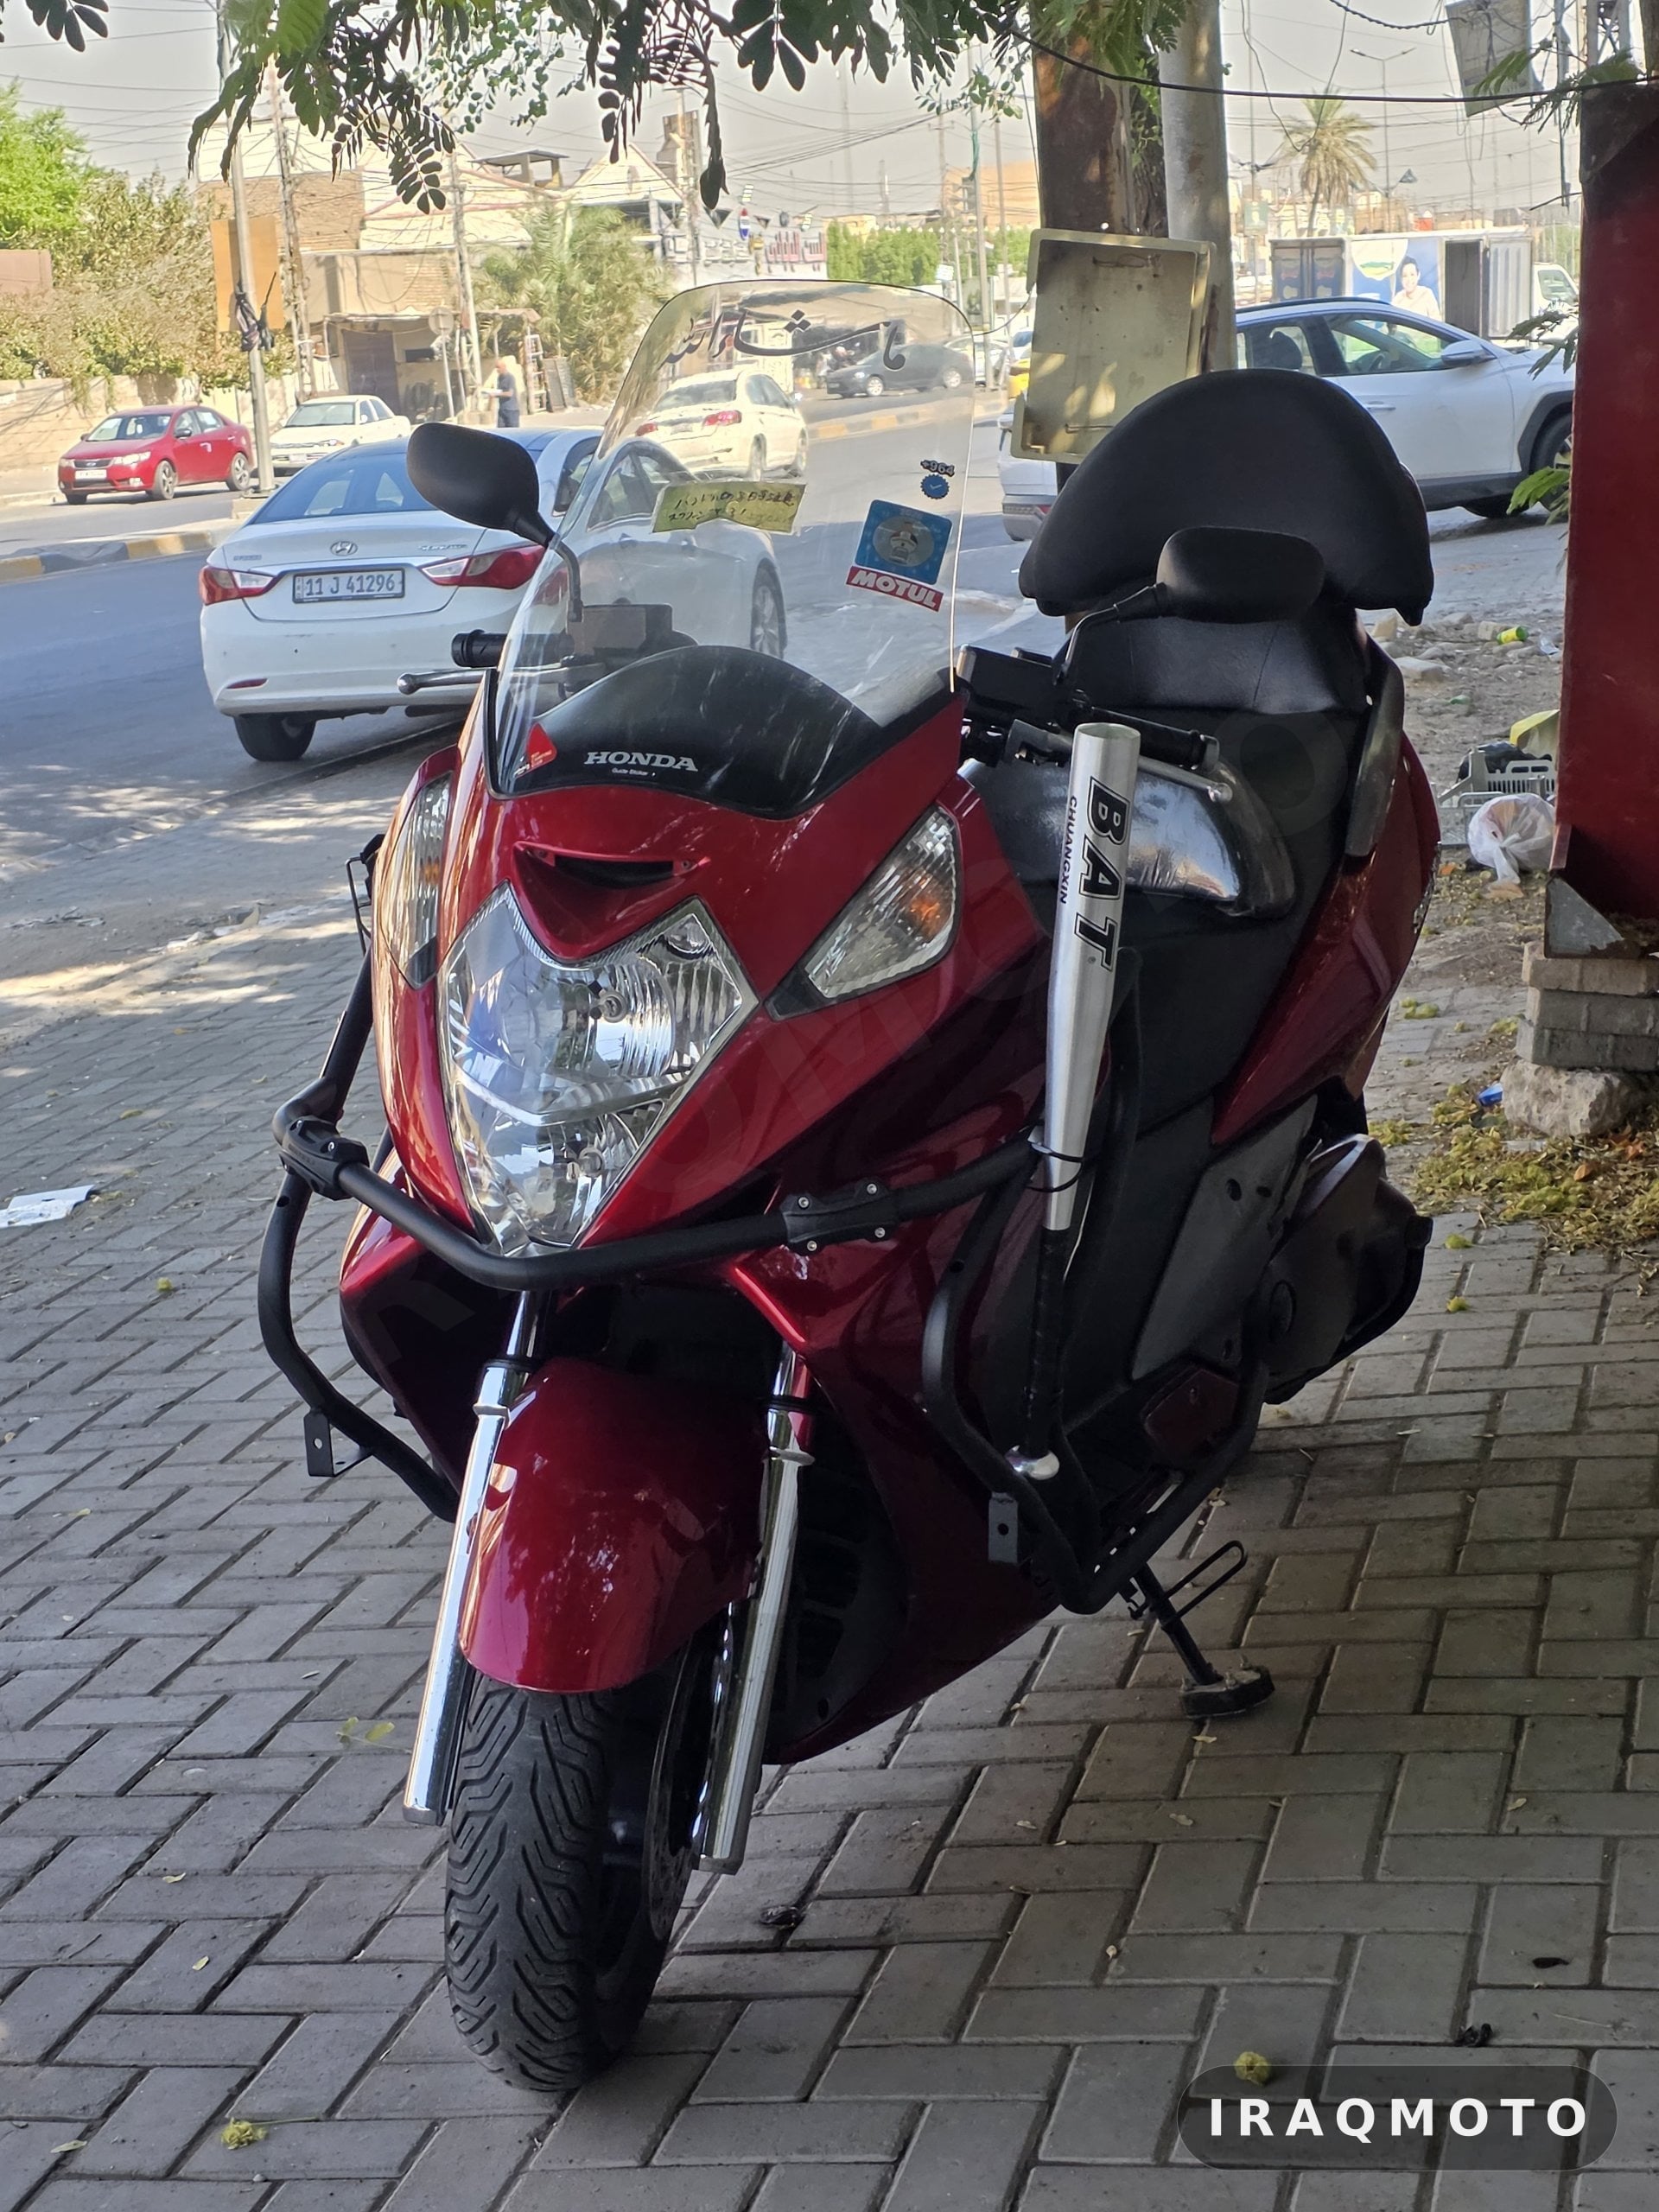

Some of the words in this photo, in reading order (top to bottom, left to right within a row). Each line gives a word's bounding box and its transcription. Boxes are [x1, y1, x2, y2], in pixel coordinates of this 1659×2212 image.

[920, 459, 955, 477] +964
[305, 578, 324, 597] 11
[330, 577, 340, 594] J
[346, 573, 396, 594] 41296
[850, 569, 938, 608] MOTUL
[584, 751, 699, 772] HONDA
[1059, 795, 1078, 905] CHUANGXIN
[1074, 775, 1131, 972] BAT
